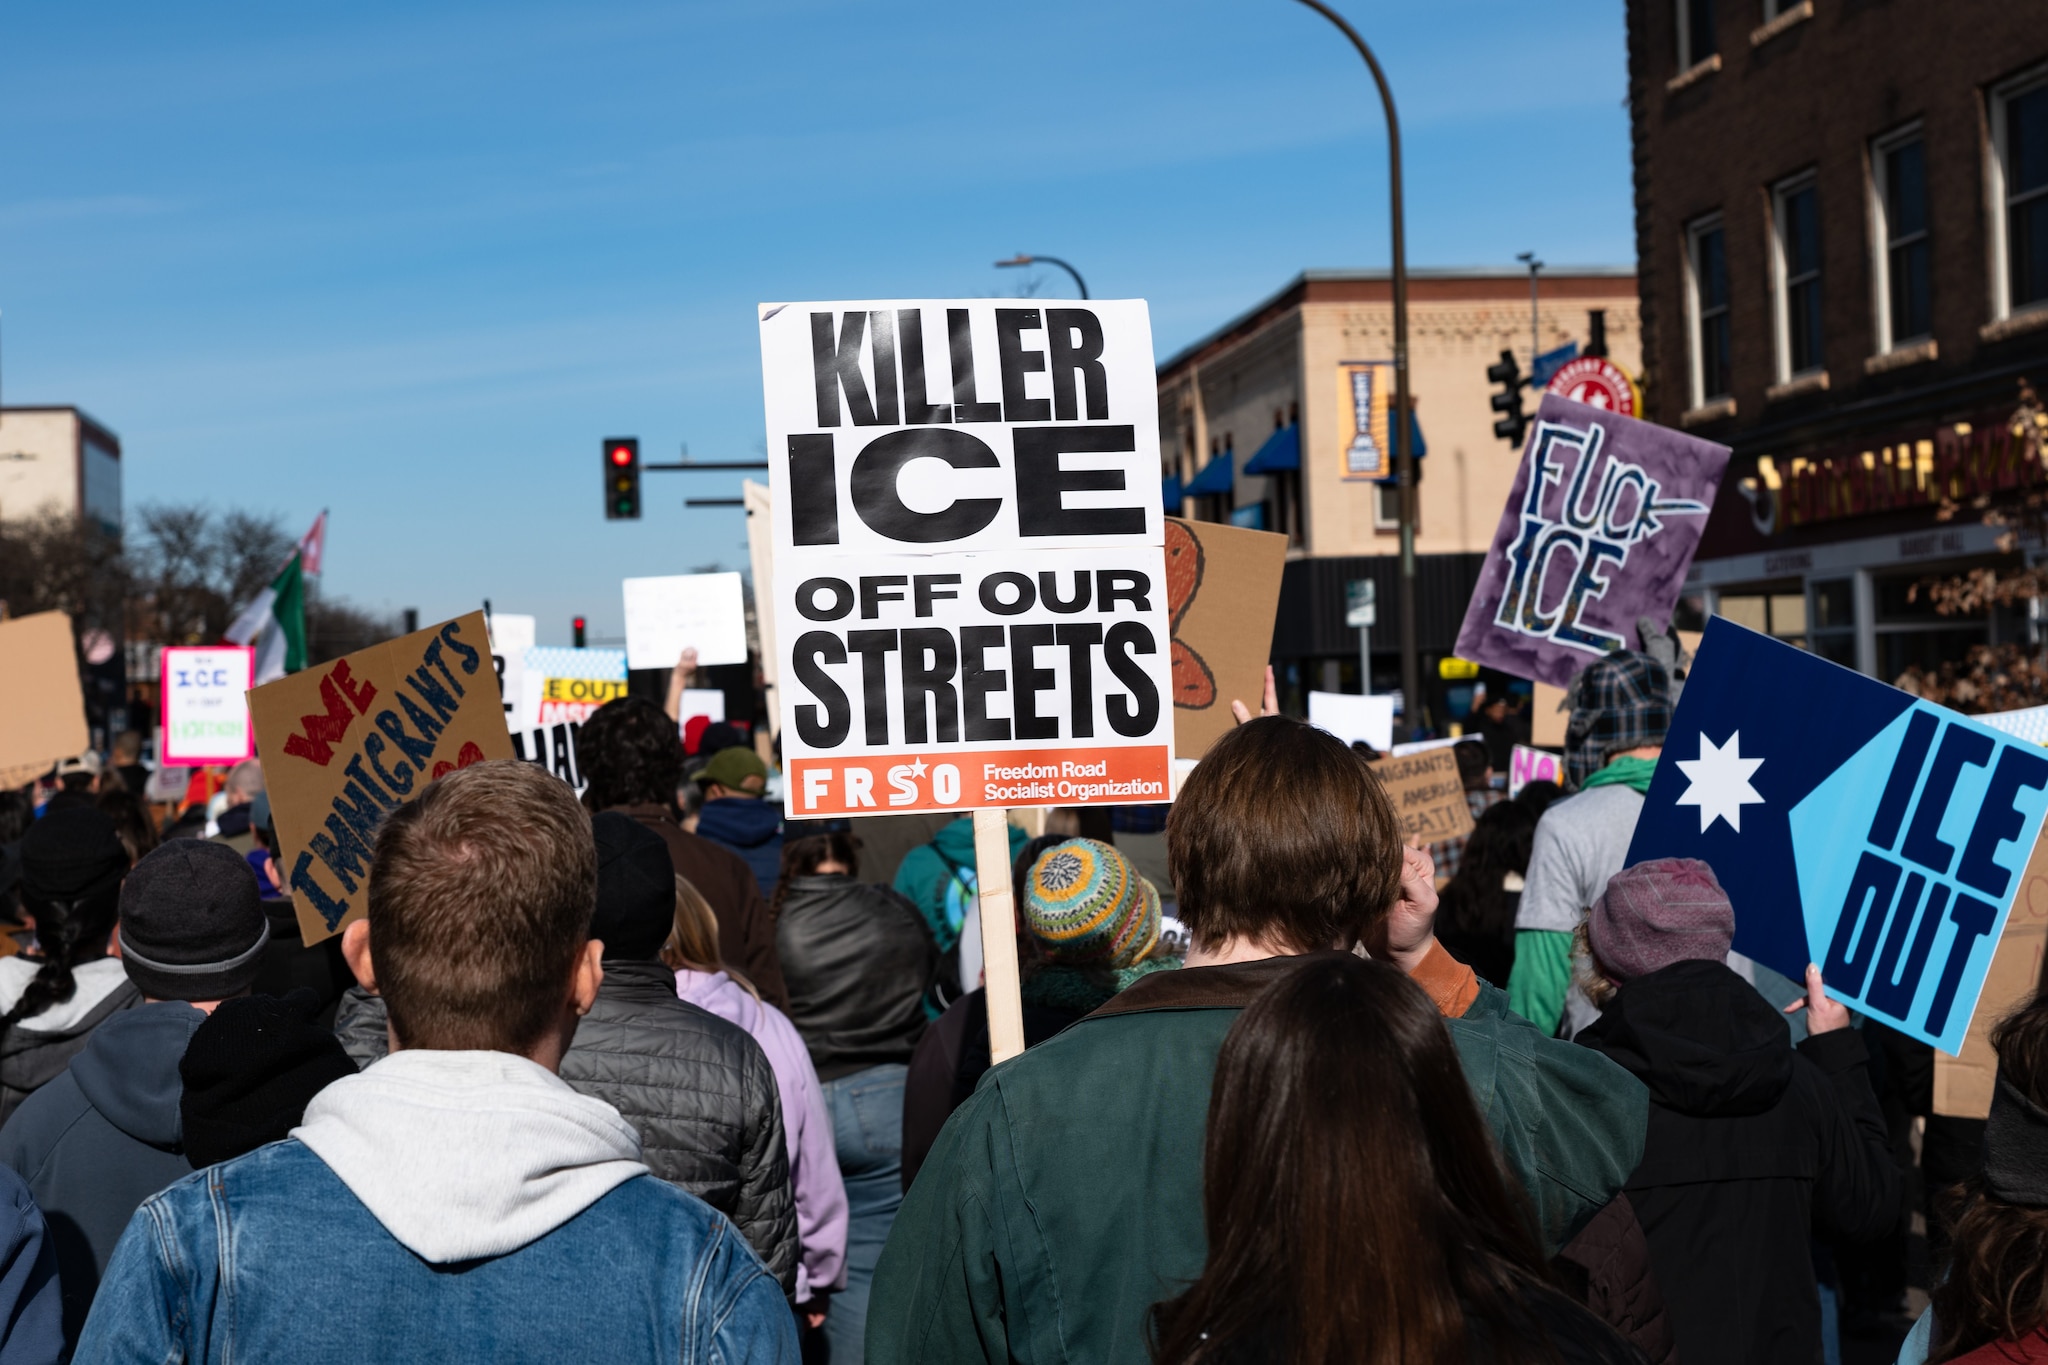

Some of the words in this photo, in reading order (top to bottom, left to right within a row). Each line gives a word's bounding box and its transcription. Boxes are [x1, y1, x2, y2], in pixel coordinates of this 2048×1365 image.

[810, 308, 1109, 427] KILLER
[787, 425, 1147, 546] ICE
[1521, 420, 1710, 546] FUCK
[795, 574, 962, 622] OFF
[979, 569, 1152, 616] OUR
[1494, 513, 1629, 656] ICE
[177, 670, 228, 687] ICE
[284, 659, 378, 766] WE
[570, 680, 624, 700] OUT
[792, 621, 1160, 748] STREETS
[290, 621, 480, 932] IMMIGRANTS
[803, 757, 961, 810] FRSO
[984, 762, 1059, 781] Freedom
[1061, 760, 1106, 778] Road
[984, 781, 1056, 801] Socialist
[1057, 778, 1163, 801] Organization
[1374, 752, 1454, 784] MIGRANTS
[1513, 747, 1555, 784] NO
[1867, 708, 2048, 899] ICE
[1406, 805, 1458, 834] EAT!
[1822, 850, 1998, 1038] OUT
